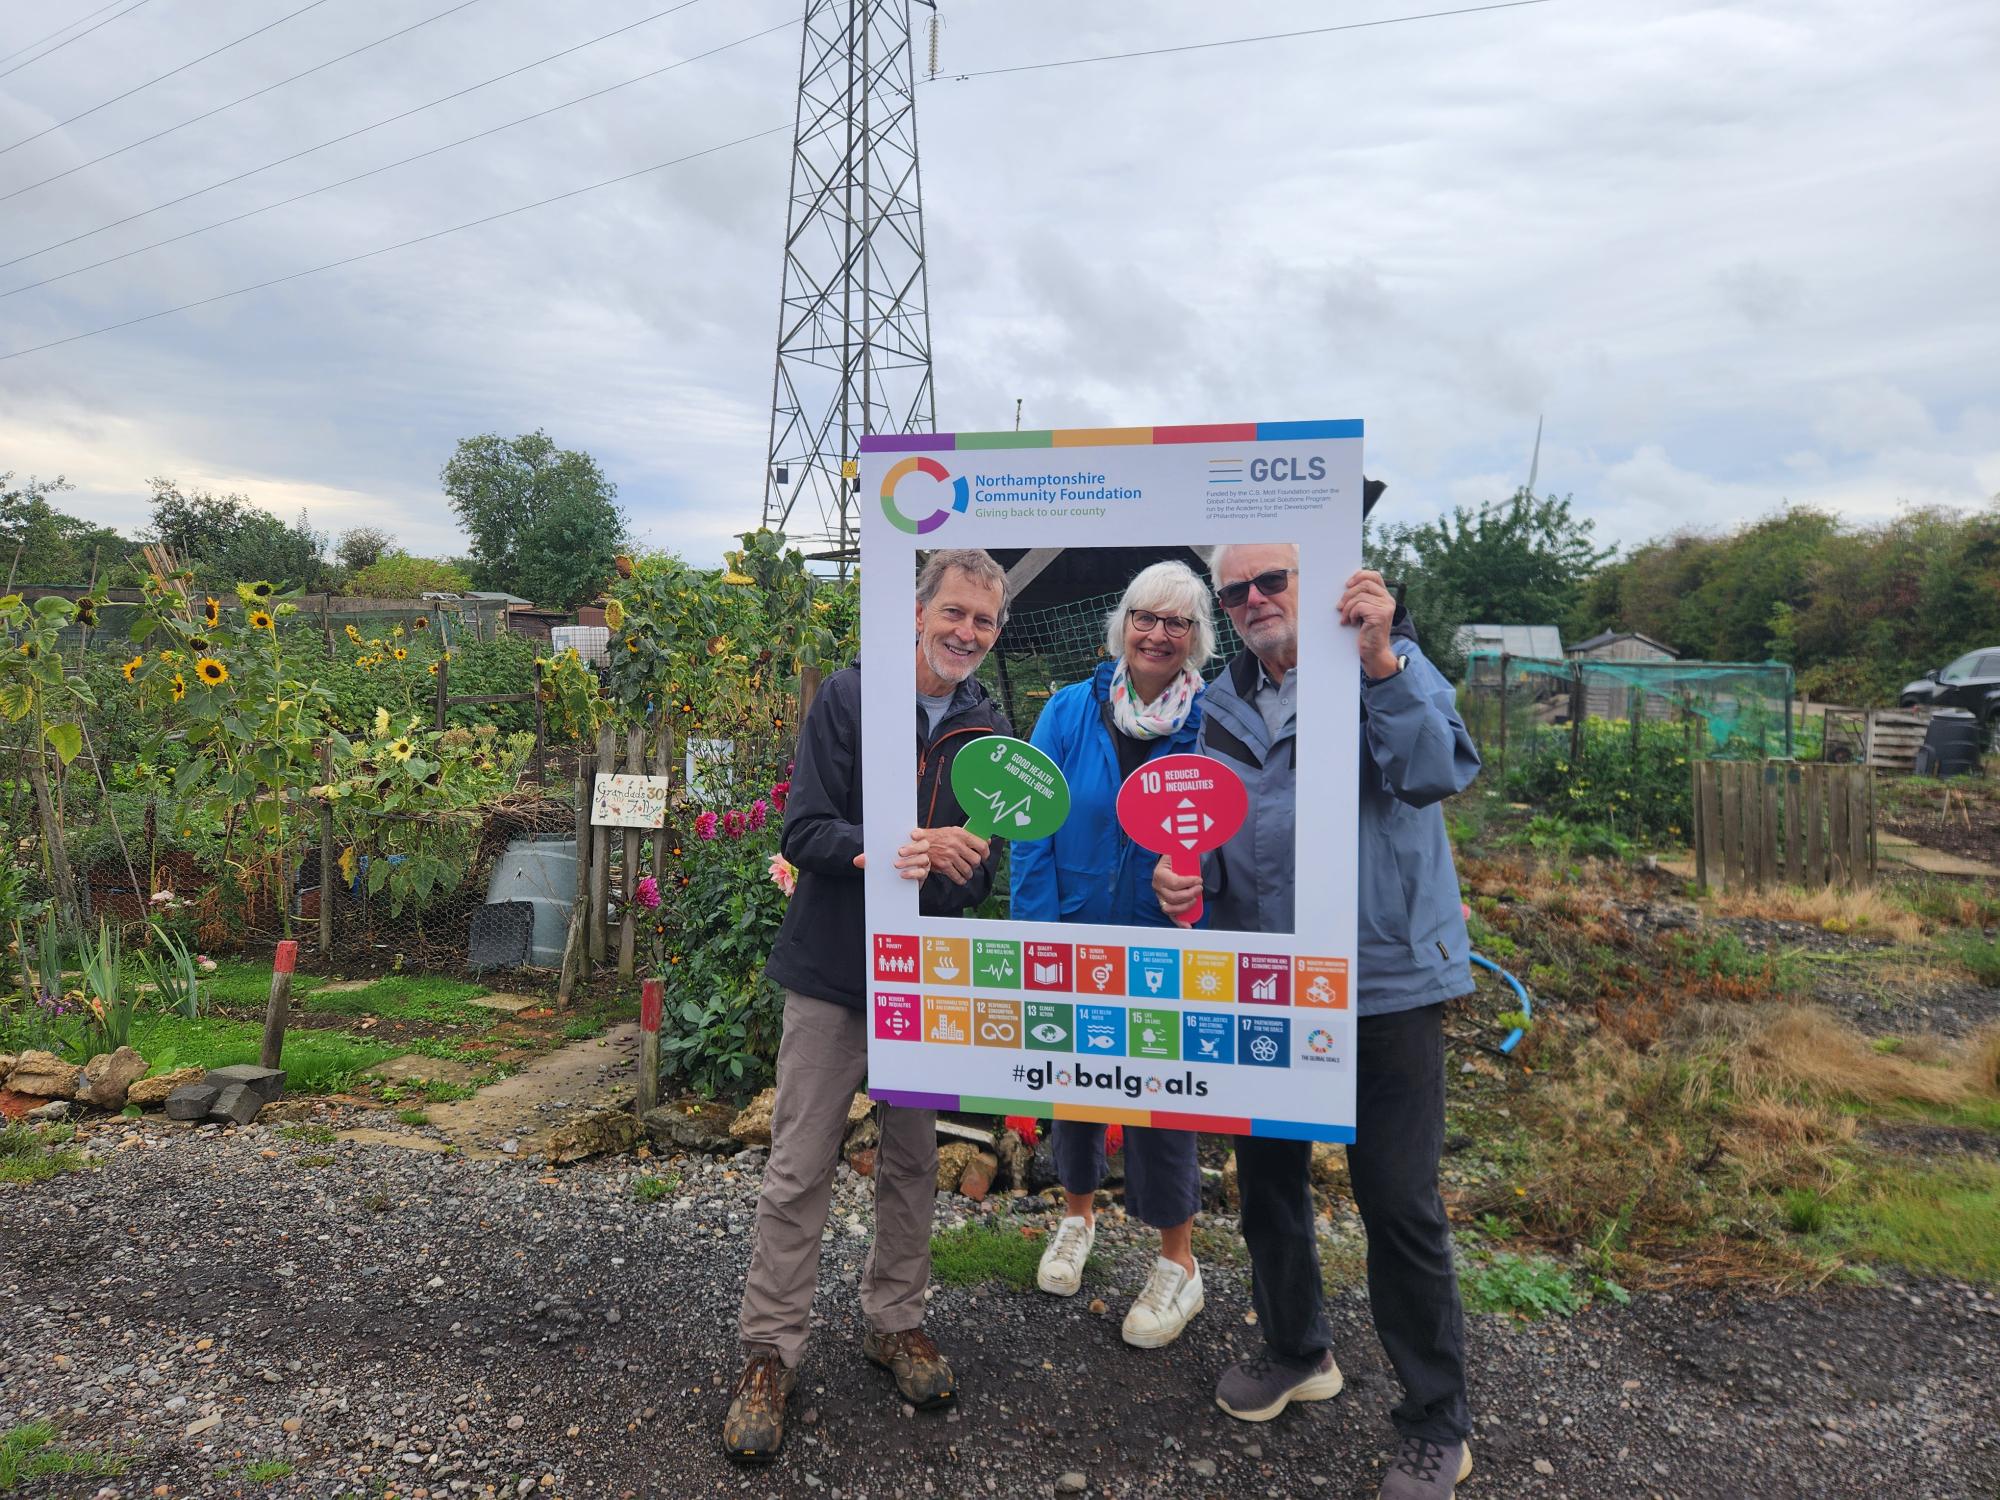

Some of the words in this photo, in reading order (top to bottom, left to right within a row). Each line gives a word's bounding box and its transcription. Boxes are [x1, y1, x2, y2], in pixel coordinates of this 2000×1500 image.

[1250, 457, 1326, 482] GCLS
[975, 472, 1106, 488] Northamptonshire
[975, 489, 1057, 503] Community
[1060, 487, 1142, 501] Foundation
[1230, 490, 1237, 498] by
[975, 508, 1008, 519] Giving
[1011, 507, 1034, 517] back
[1037, 508, 1048, 516] to
[1050, 509, 1068, 517] our
[1070, 507, 1106, 518] county
[990, 744, 1007, 763] 3
[1011, 753, 1031, 769] GOOD
[1028, 764, 1055, 786] HEALTH
[1164, 768, 1200, 781] REDUCED
[1004, 762, 1020, 776] AND
[1018, 771, 1055, 800] WELL-BEING
[1140, 771, 1161, 794] 10
[1166, 779, 1214, 793] INEQUALITIES
[878, 938, 883, 948] 1
[927, 940, 933, 951] 2
[977, 943, 983, 954] 3
[1028, 945, 1034, 957] 4
[1080, 948, 1086, 959] 5
[1133, 951, 1140, 962] 6
[1187, 954, 1193, 965] 7
[1242, 956, 1249, 968] 8
[1298, 960, 1305, 972] 9
[877, 996, 887, 1007] 10
[927, 999, 934, 1010] 11
[977, 1002, 986, 1013] 12
[1027, 1005, 1037, 1017] 13
[1080, 1008, 1089, 1020] 14
[1133, 1012, 1142, 1023] 15
[1186, 1015, 1197, 1027] 16
[1242, 1019, 1251, 1031] 17
